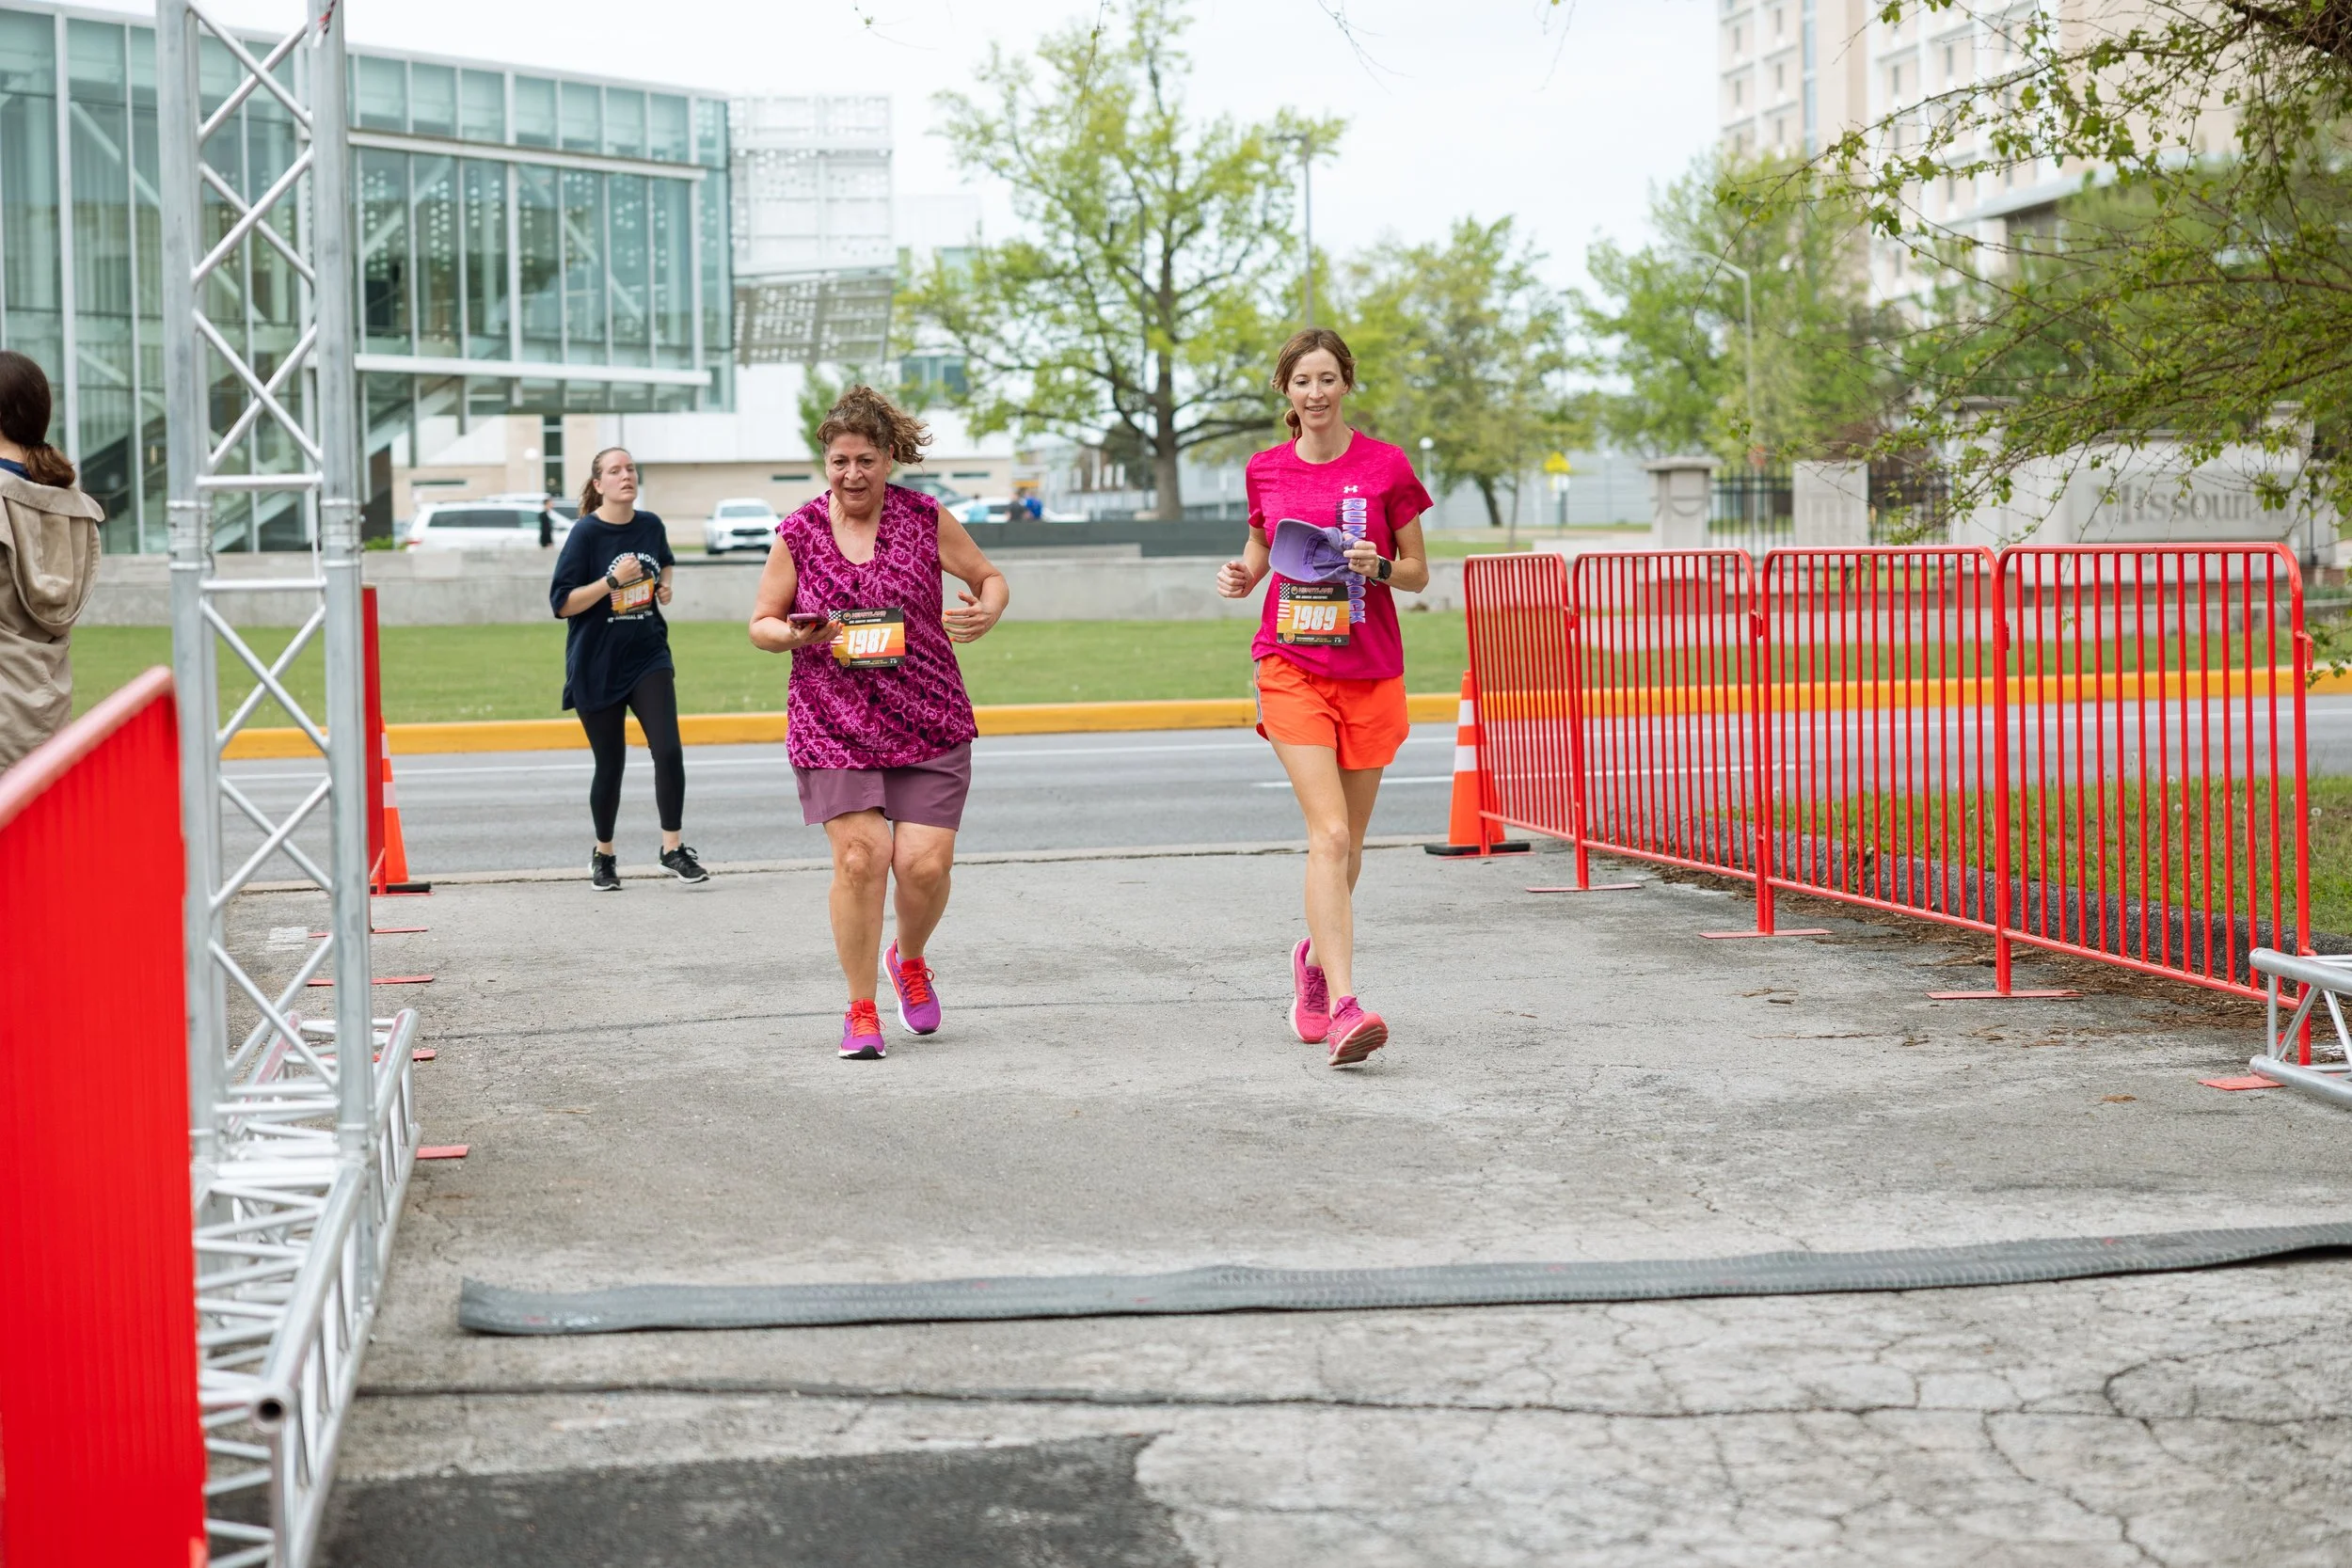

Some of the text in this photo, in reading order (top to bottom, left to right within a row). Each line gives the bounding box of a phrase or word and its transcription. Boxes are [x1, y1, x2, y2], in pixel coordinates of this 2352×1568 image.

[1343, 498, 1367, 538] RUN
[1292, 605, 1339, 631] 1989
[848, 627, 892, 656] 1987
